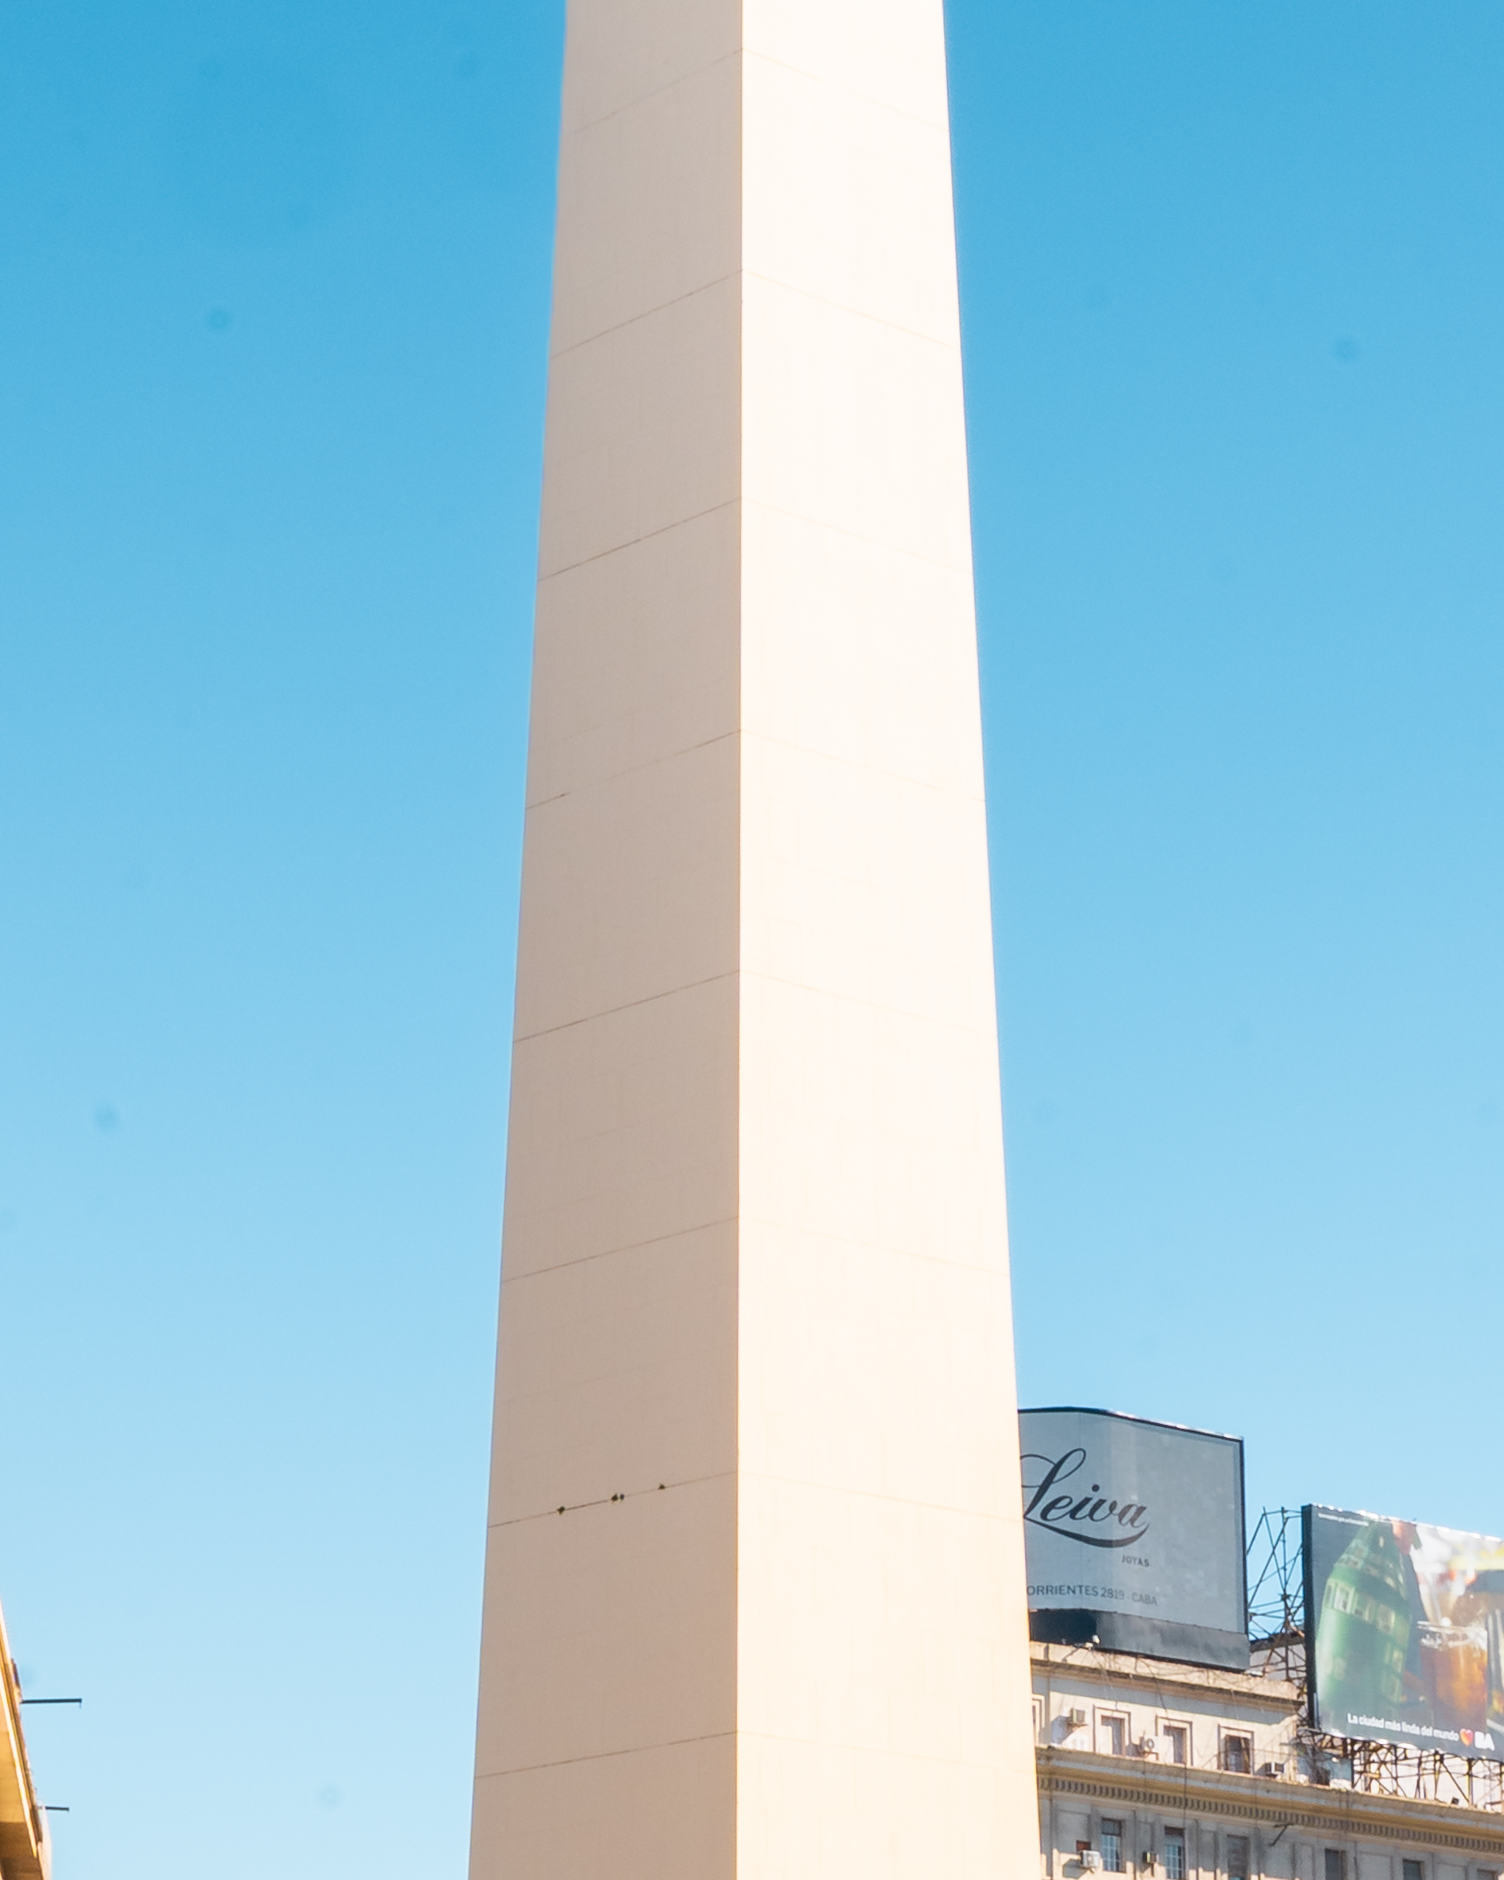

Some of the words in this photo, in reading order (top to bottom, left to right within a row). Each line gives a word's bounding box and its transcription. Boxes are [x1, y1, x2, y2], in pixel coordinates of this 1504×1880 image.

[1020, 1448, 1150, 1548] Leiva
[1121, 1554, 1150, 1568] JOYAS
[1027, 1584, 1098, 1597] ORRIENTES
[1132, 1592, 1158, 1606] CABA
[1347, 1712, 1358, 1724] La
[1474, 1731, 1495, 1751] BA
